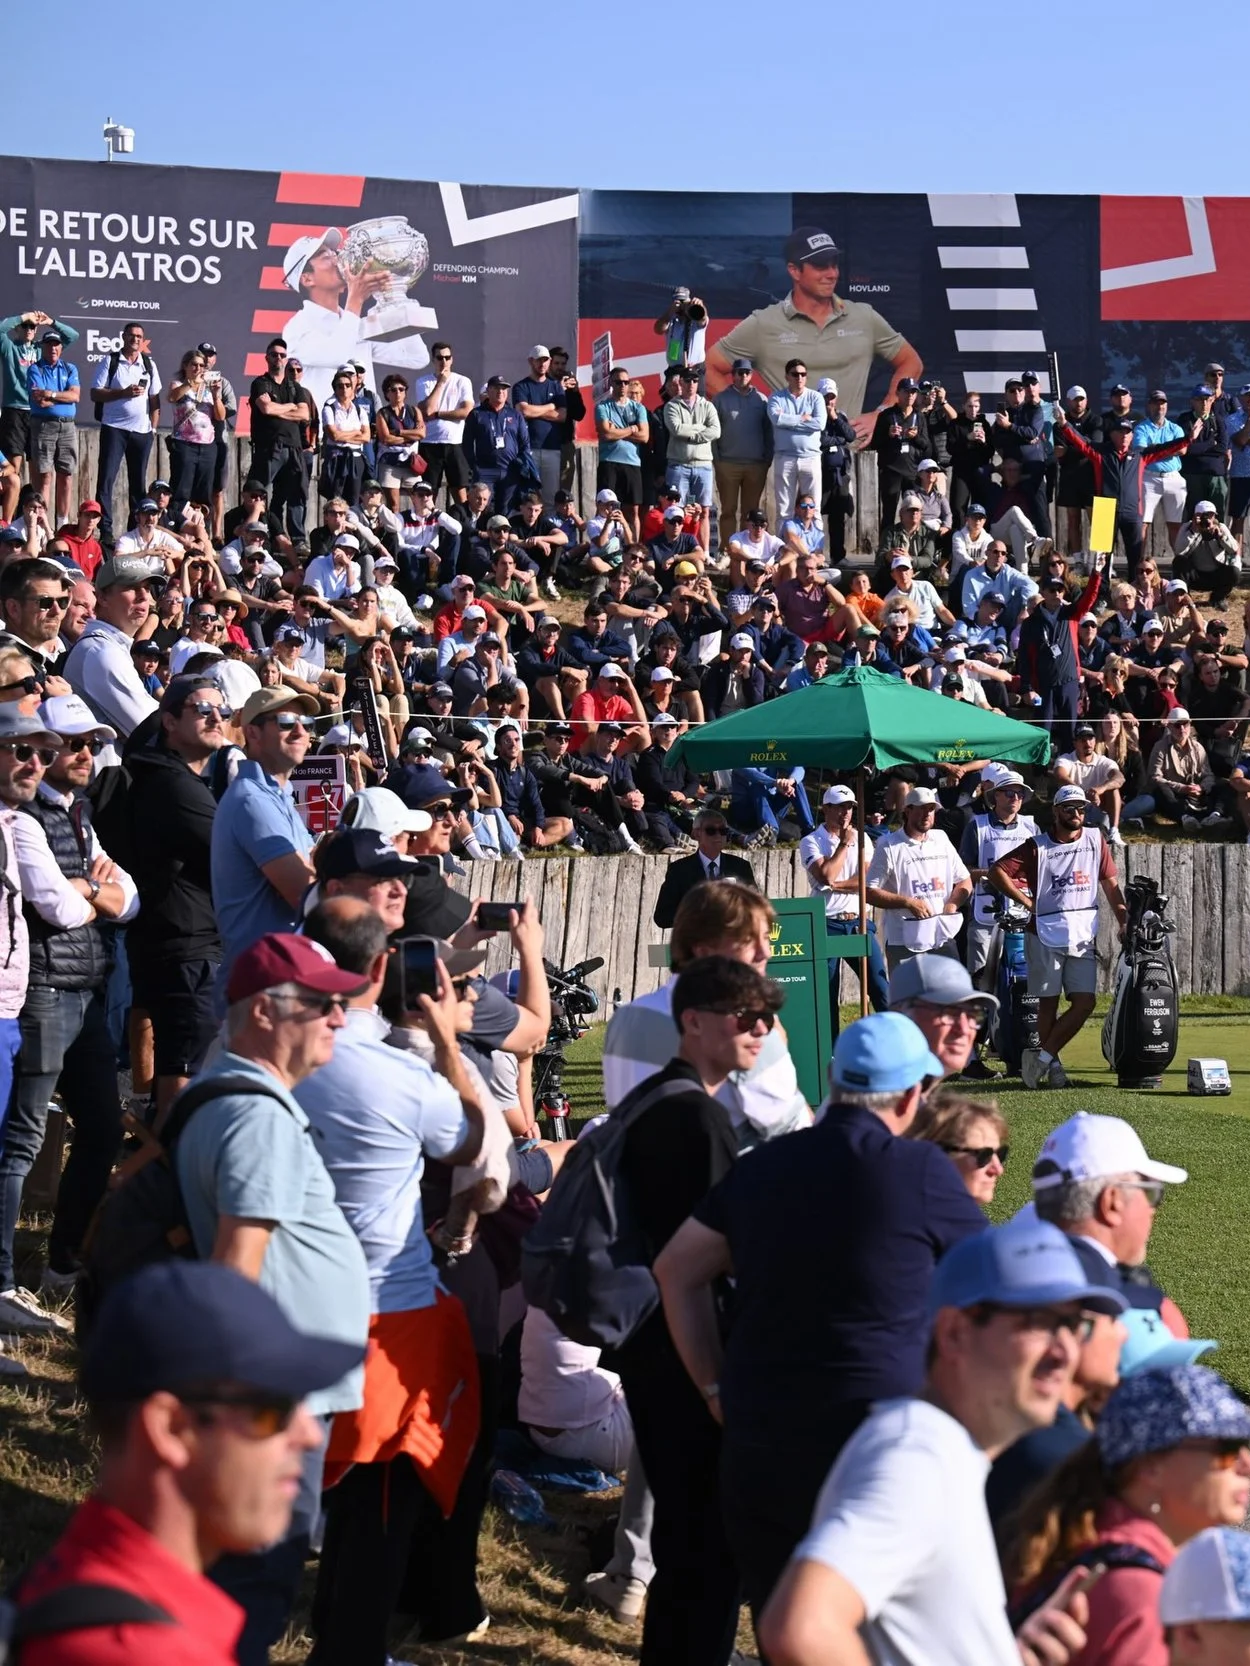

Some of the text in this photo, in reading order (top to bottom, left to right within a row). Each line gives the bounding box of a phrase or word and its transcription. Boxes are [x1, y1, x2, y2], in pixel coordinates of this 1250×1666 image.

[0, 207, 258, 250] E RETOUR SUR
[18, 246, 222, 285] L'ALBATROS
[433, 263, 519, 275] DEFENDING CHAMPION
[462, 275, 476, 283] KIM
[91, 299, 160, 310] DP WORLD TOUR
[363, 692, 378, 749] SILENCE
[750, 752, 787, 761] ROLEX
[938, 750, 974, 759] ROLEX
[911, 877, 945, 893] FedEx
[1052, 871, 1090, 888] FedEx
[770, 944, 804, 957] LEX
